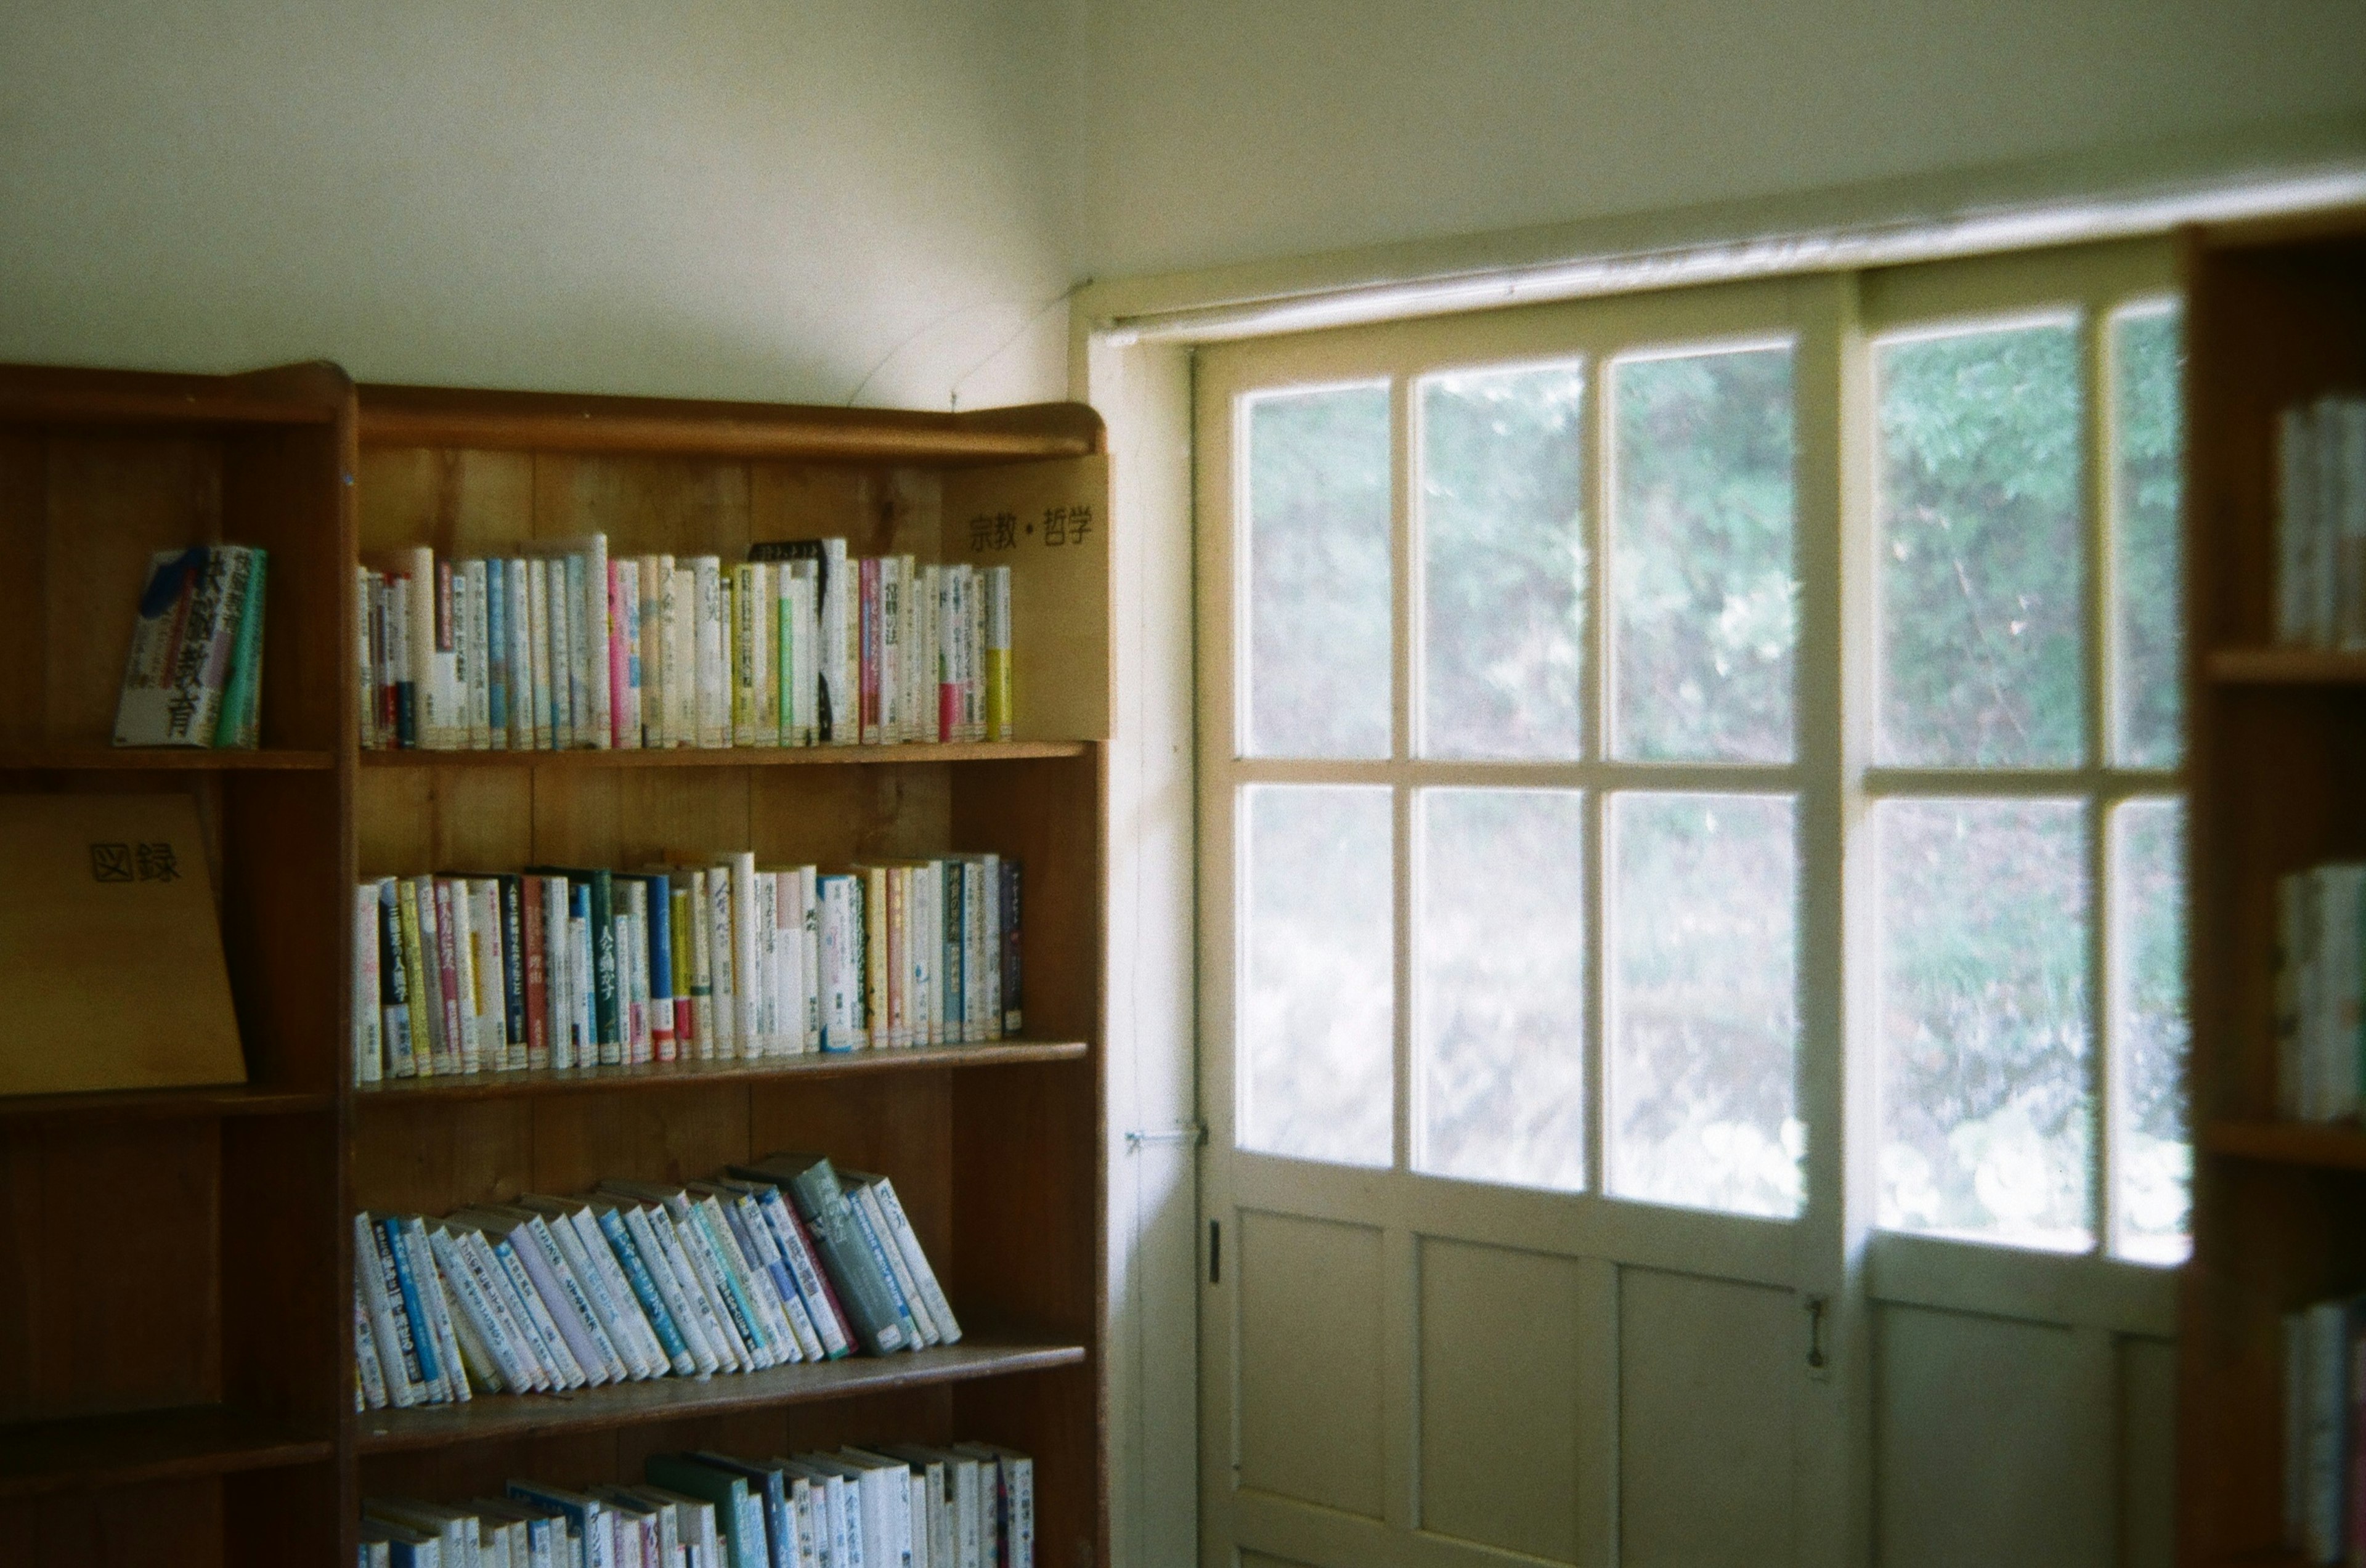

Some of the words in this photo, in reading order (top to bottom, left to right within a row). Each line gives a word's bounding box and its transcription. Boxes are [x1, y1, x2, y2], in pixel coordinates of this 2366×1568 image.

[969, 507, 1092, 553] 宗教・哲学
[90, 842, 182, 884] 図録
